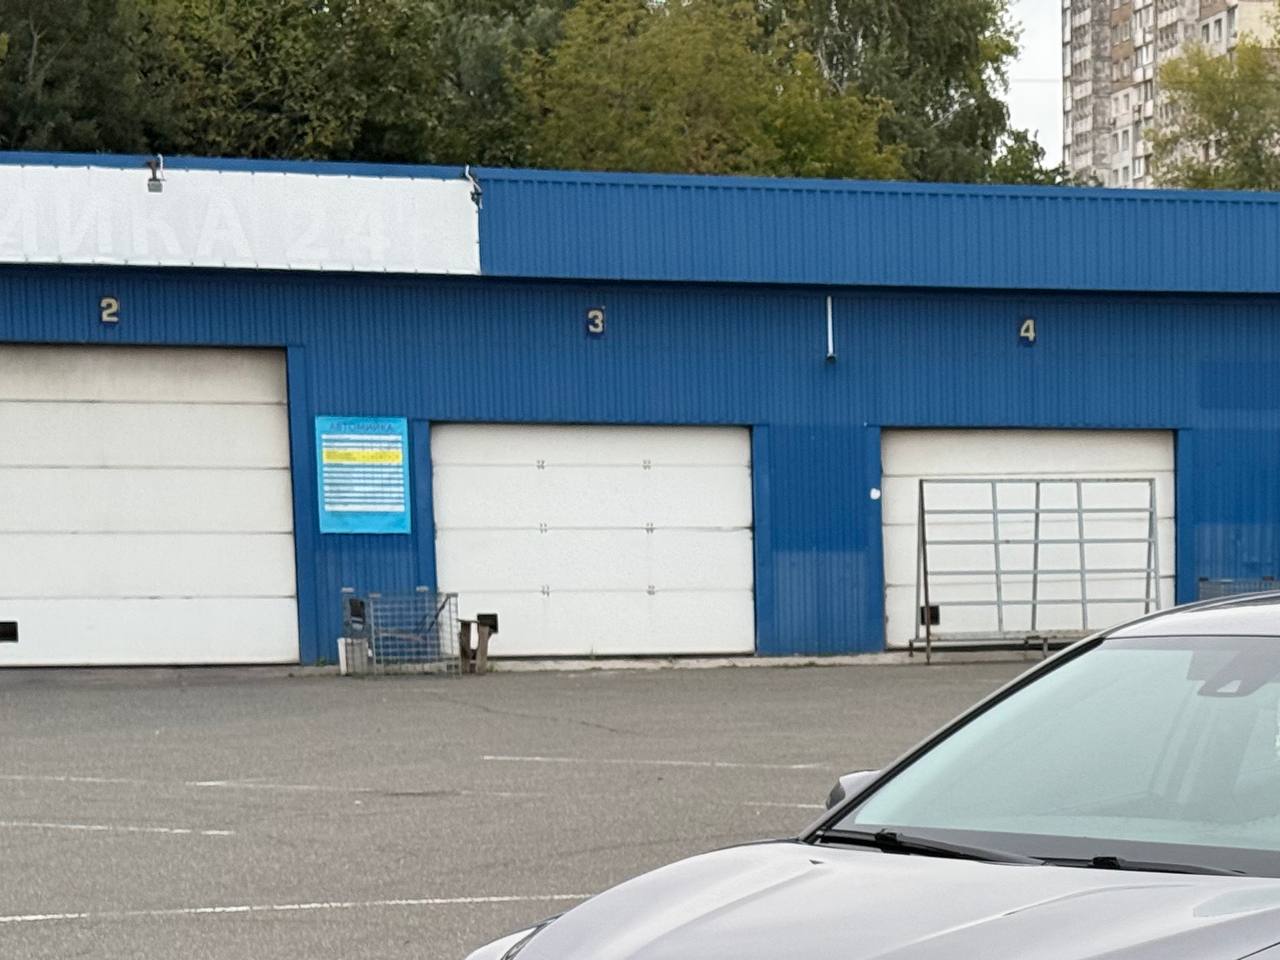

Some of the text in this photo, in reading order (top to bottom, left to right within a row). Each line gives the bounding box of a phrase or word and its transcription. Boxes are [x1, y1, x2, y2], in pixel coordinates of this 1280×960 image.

[100, 297, 119, 322] 2
[588, 310, 604, 333] 3
[1020, 319, 1036, 341] 4
